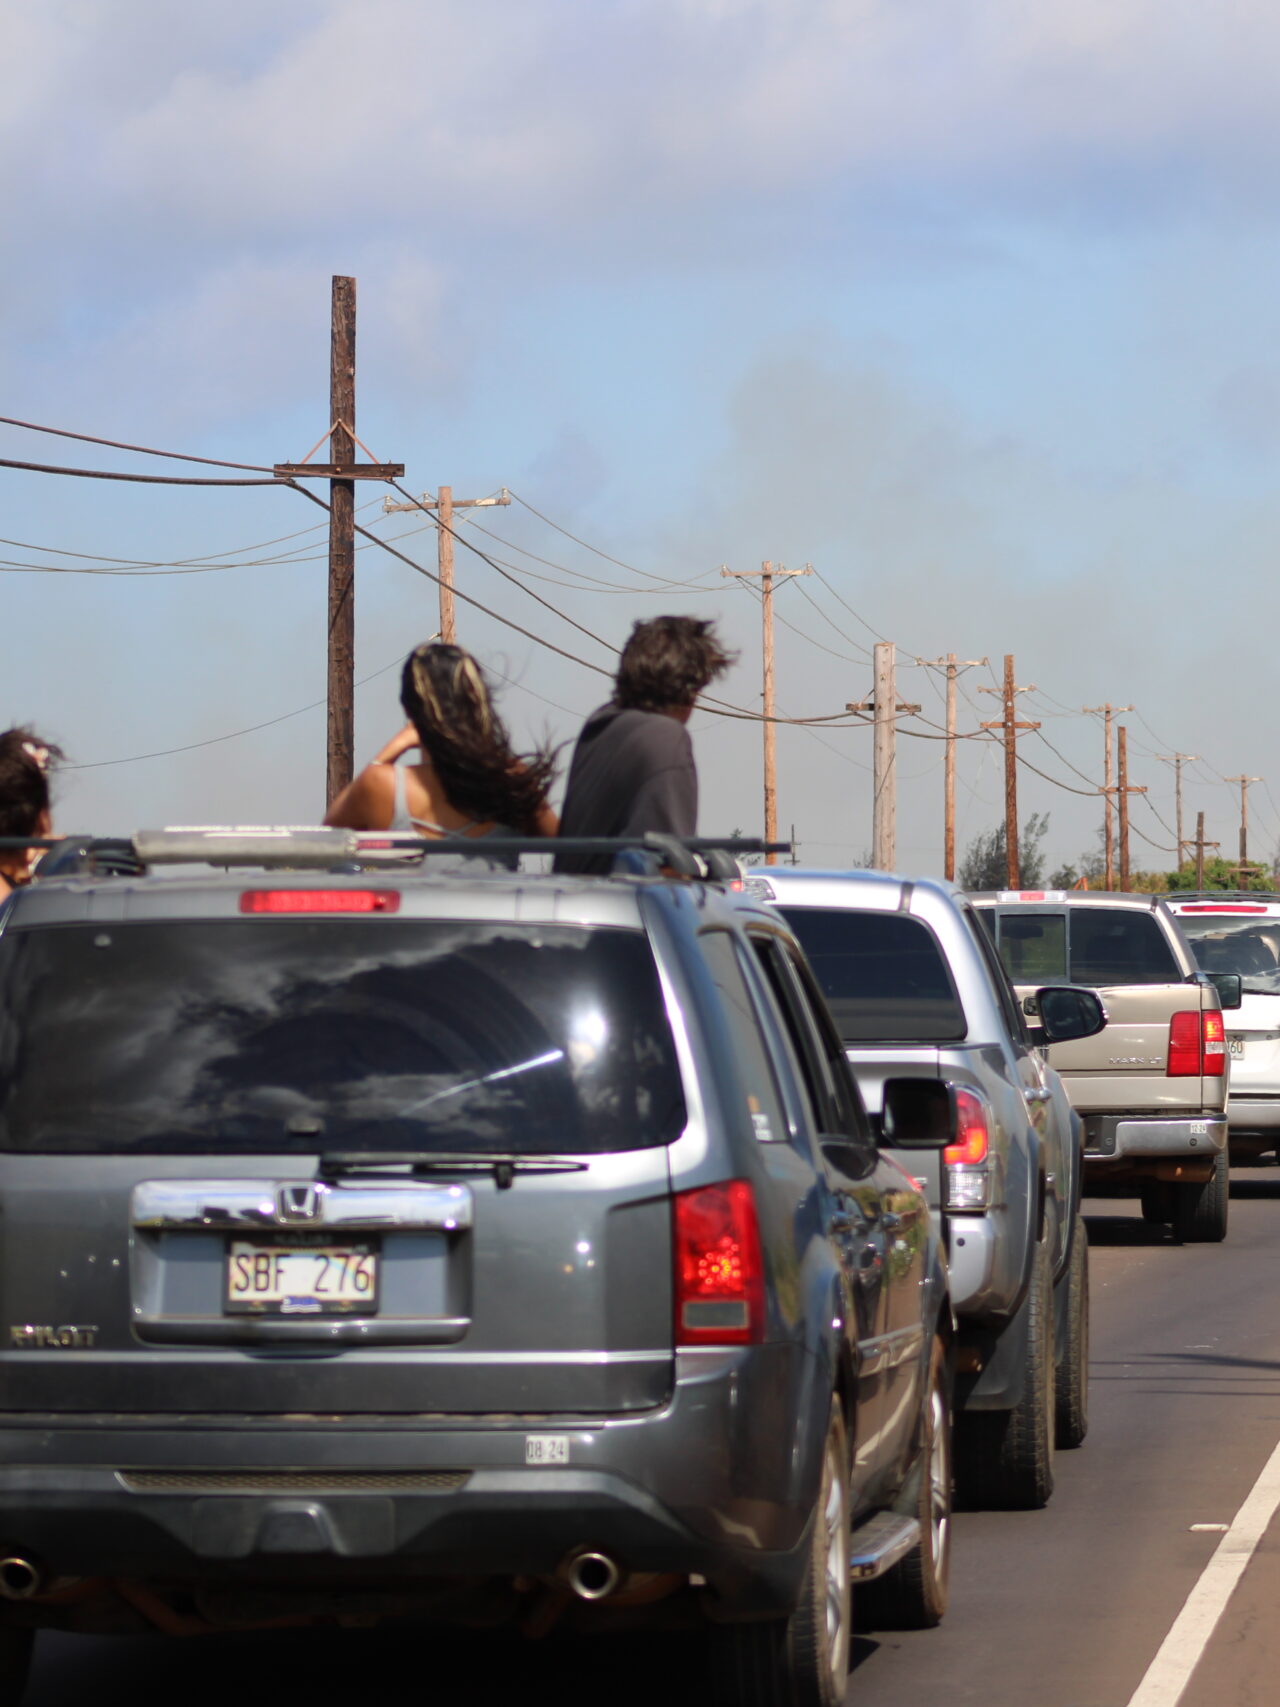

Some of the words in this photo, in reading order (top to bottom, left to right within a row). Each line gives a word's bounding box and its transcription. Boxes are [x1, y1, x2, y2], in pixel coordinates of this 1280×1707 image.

[1149, 1056, 1163, 1064] LT
[235, 1253, 291, 1292] SBF
[313, 1253, 370, 1293] 276
[10, 1325, 98, 1347] PILOT
